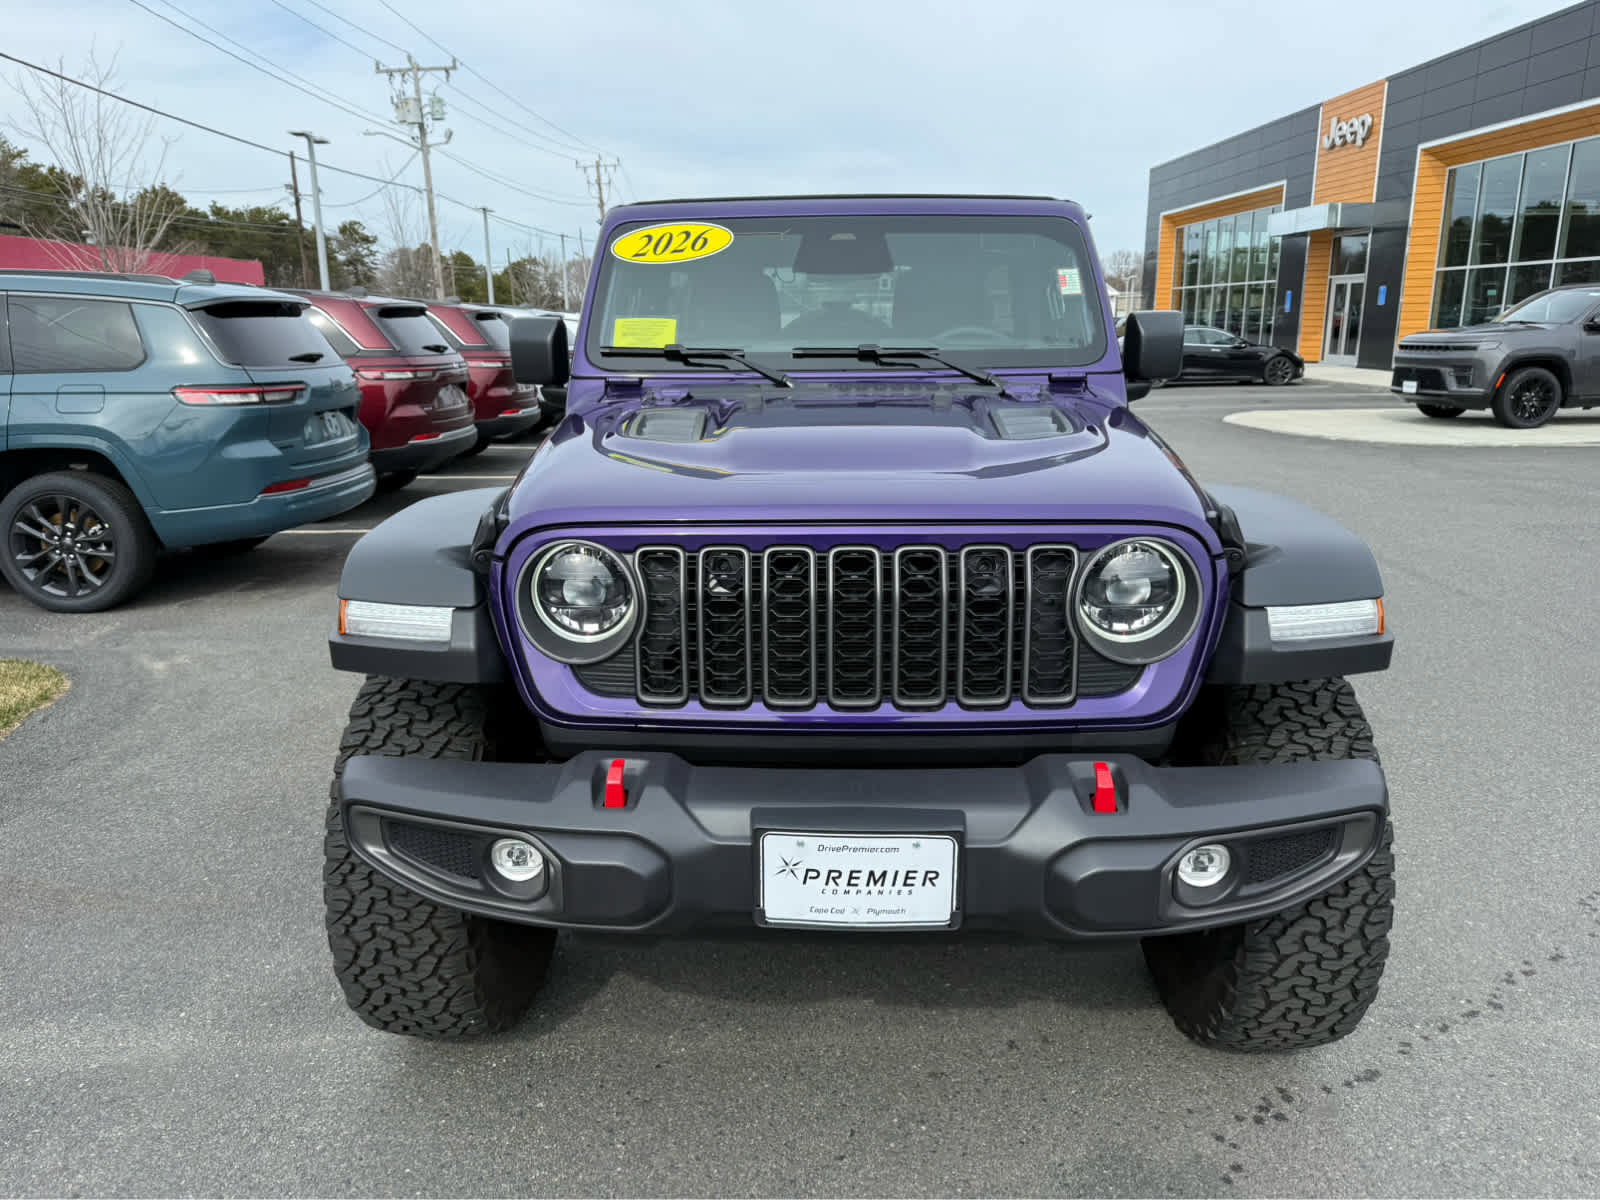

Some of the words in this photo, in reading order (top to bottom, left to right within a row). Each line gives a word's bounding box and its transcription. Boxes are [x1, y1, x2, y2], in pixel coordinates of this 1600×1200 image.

[1322, 113, 1373, 150] Jeep
[631, 228, 714, 258] 2026
[817, 844, 900, 854] DrivePremier.com
[802, 868, 940, 887] PREMIER
[821, 888, 913, 896] COMPANIES
